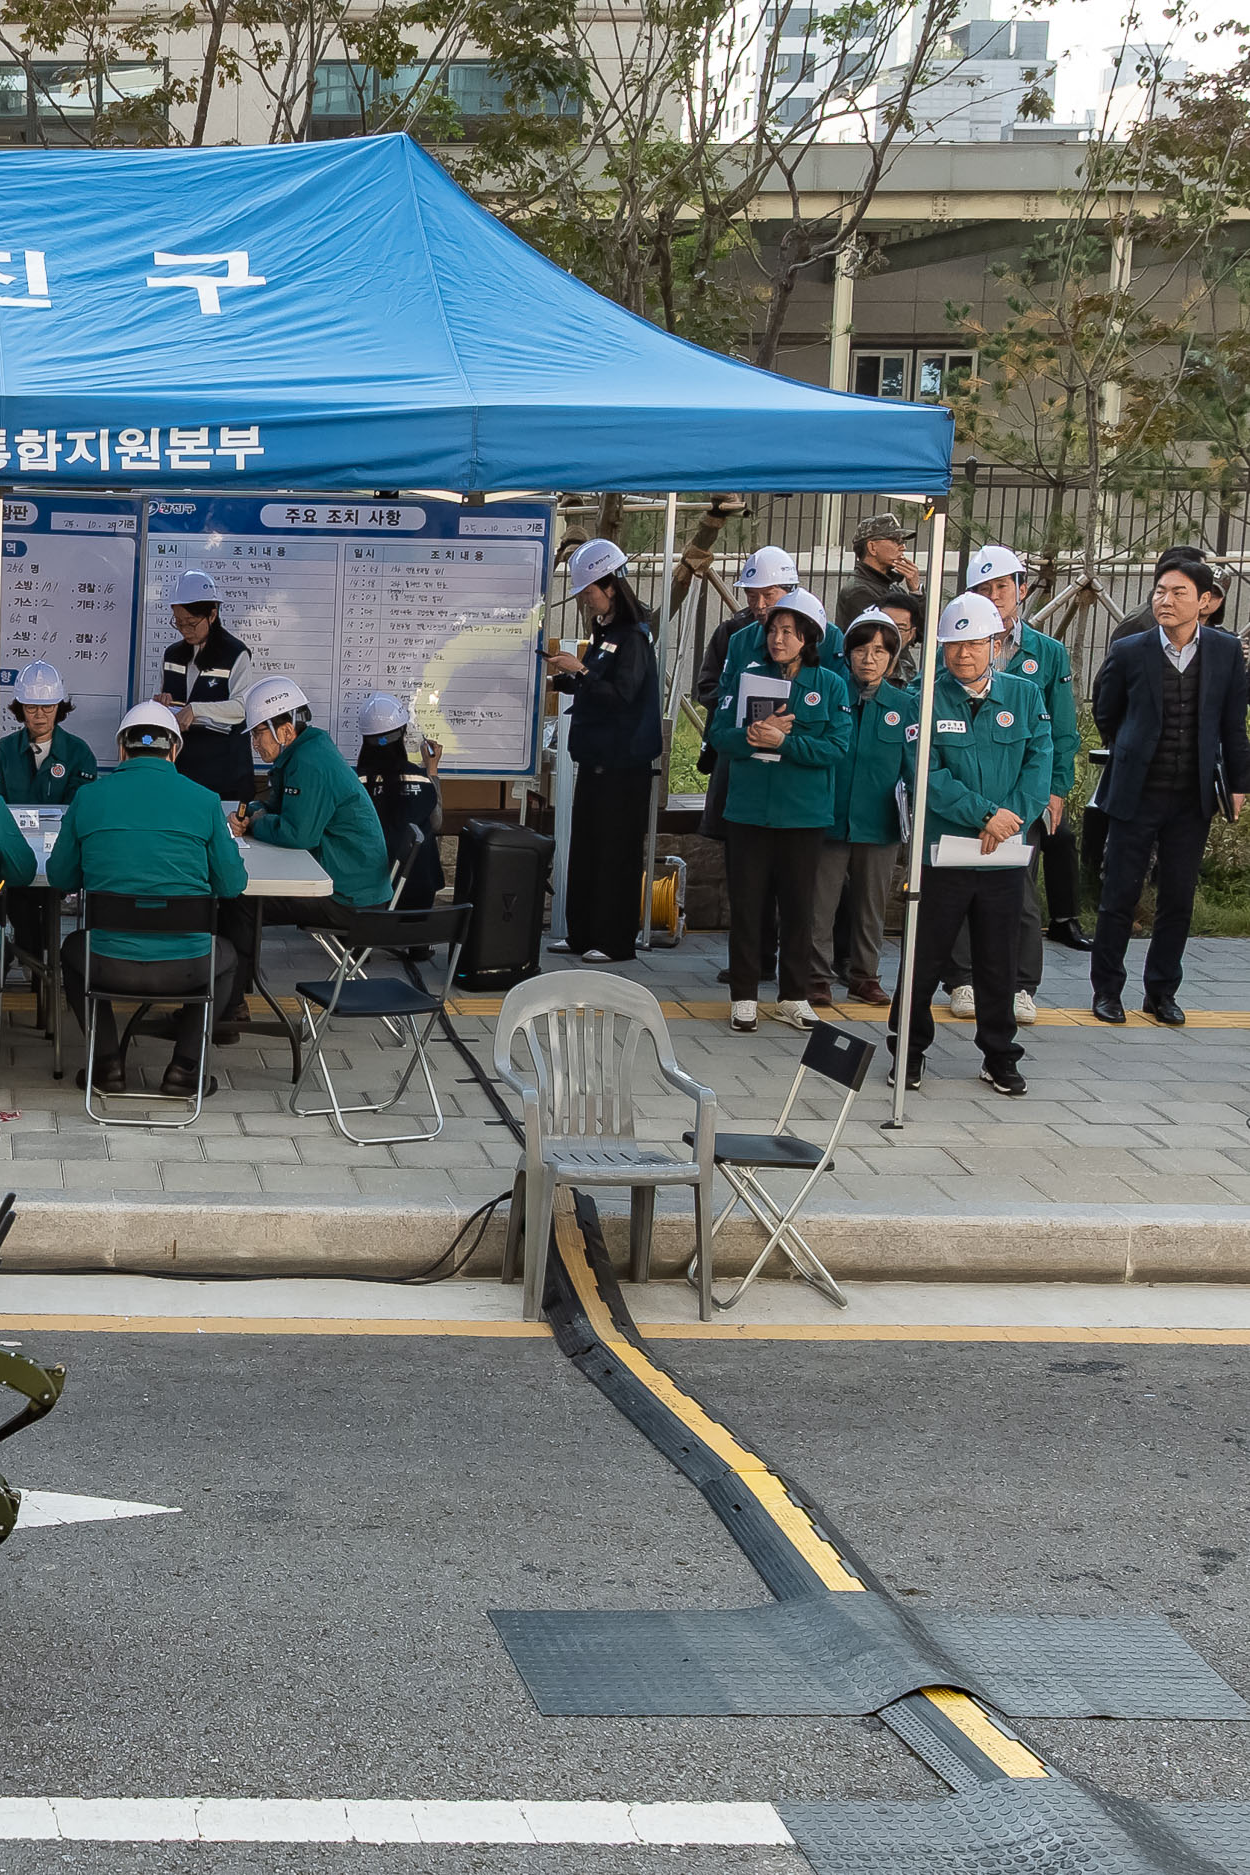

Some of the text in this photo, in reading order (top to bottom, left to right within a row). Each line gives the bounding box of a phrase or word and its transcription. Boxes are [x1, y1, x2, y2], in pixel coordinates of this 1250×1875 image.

[158, 502, 196, 515] 광진구
[285, 508, 401, 526] 주요 조치 사항
[118, 519, 135, 529] 기준
[527, 523, 543, 533] 기준
[157, 544, 286, 557] 일시 조치내용
[354, 549, 484, 561] 일시 조치내용
[31, 564, 39, 574] 명
[29, 615, 37, 624] 대
